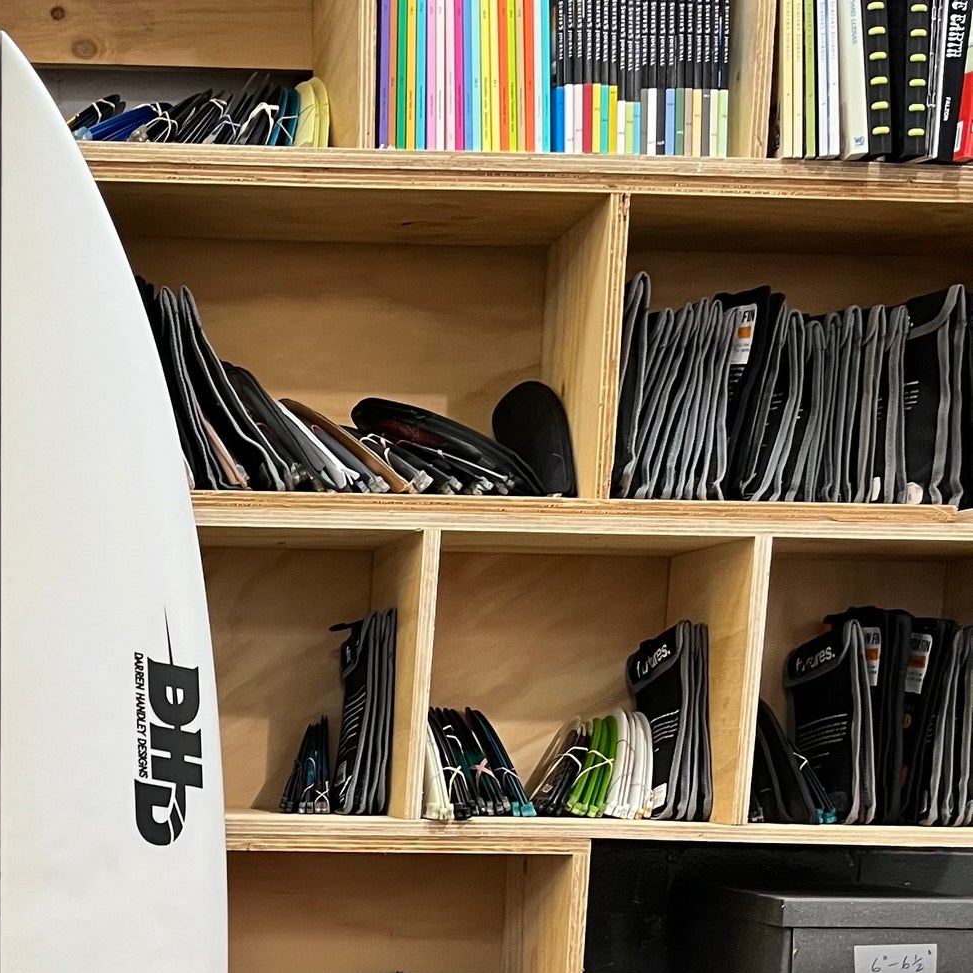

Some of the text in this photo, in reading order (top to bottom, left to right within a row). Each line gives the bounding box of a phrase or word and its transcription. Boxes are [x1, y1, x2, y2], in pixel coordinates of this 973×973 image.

[945, 14, 967, 59] EARTH
[134, 651, 149, 779] DARREN HANDLEY DESIGNS
[134, 656, 204, 846] DHD
